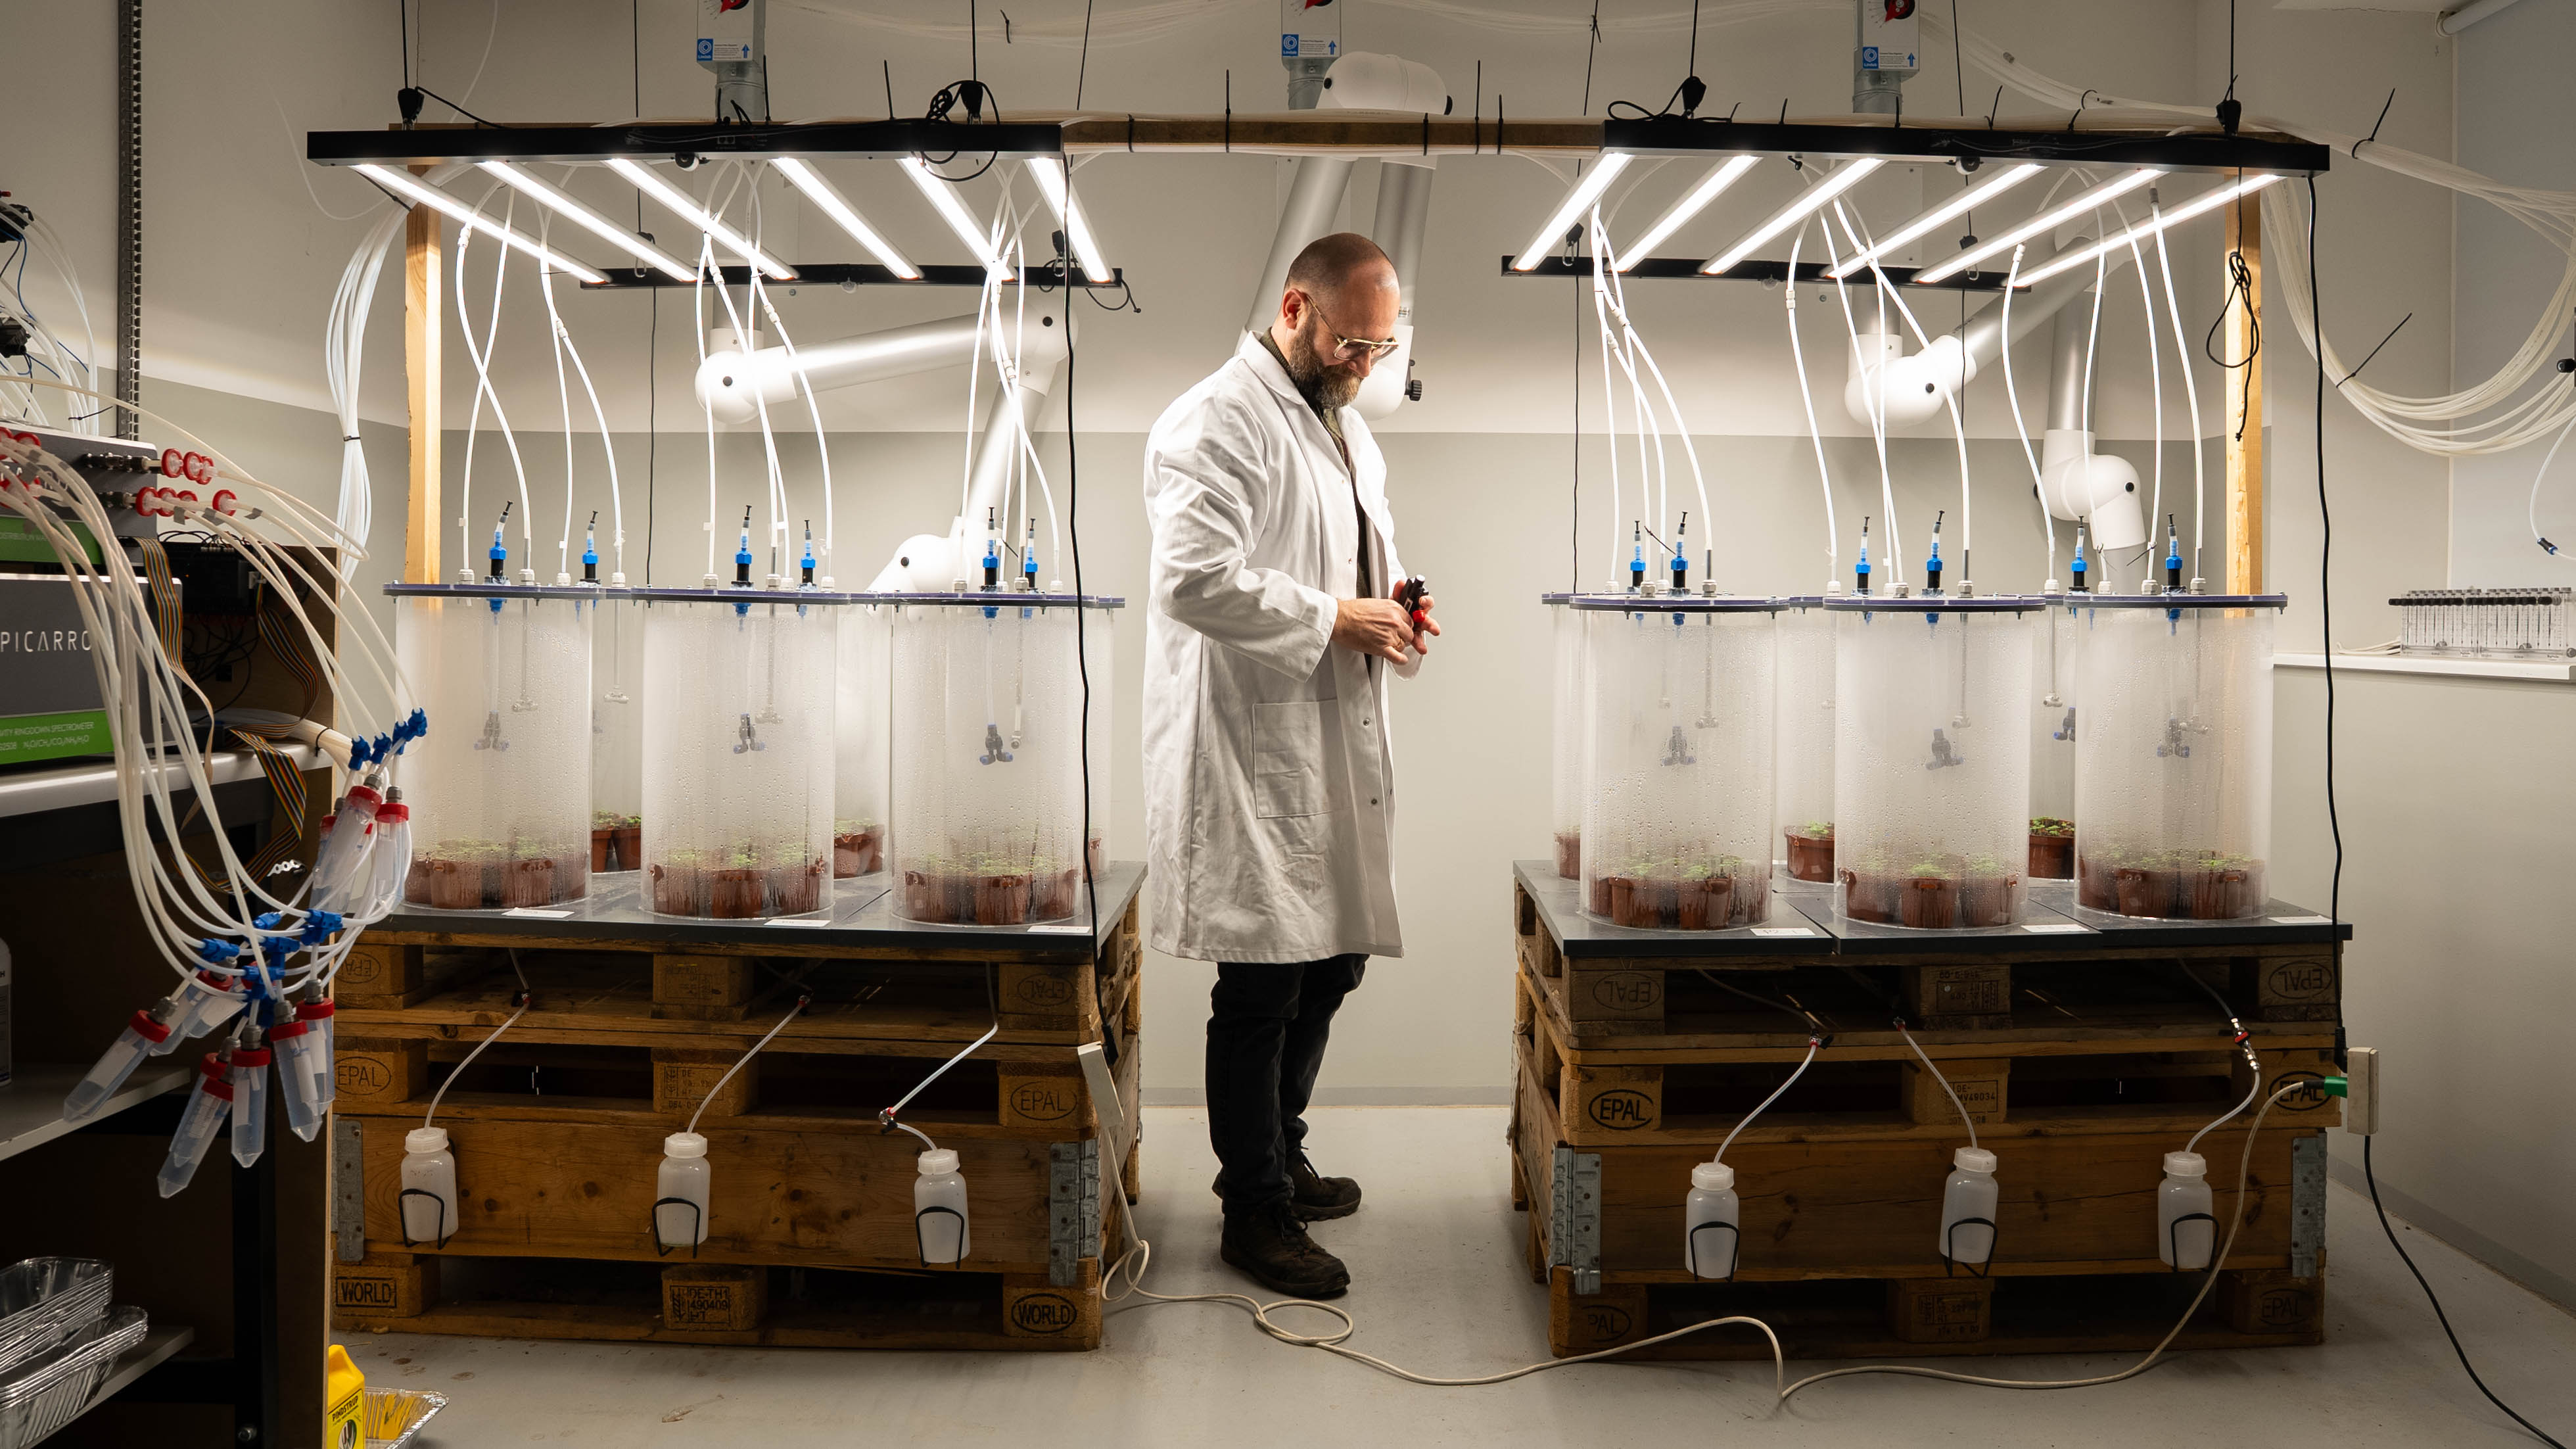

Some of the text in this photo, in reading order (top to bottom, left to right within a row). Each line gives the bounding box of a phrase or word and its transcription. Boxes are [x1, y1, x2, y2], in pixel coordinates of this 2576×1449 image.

[1604, 980, 1651, 1003] EPAL
[2278, 969, 2322, 992] EPAL
[338, 1066, 382, 1087] EPAL
[1020, 1090, 1067, 1111] EPAL
[1600, 1098, 1646, 1121] EPAL
[341, 1283, 392, 1303] WORLD
[1018, 1304, 1070, 1325] WORLD
[332, 1395, 358, 1421] PINDSTRUP
